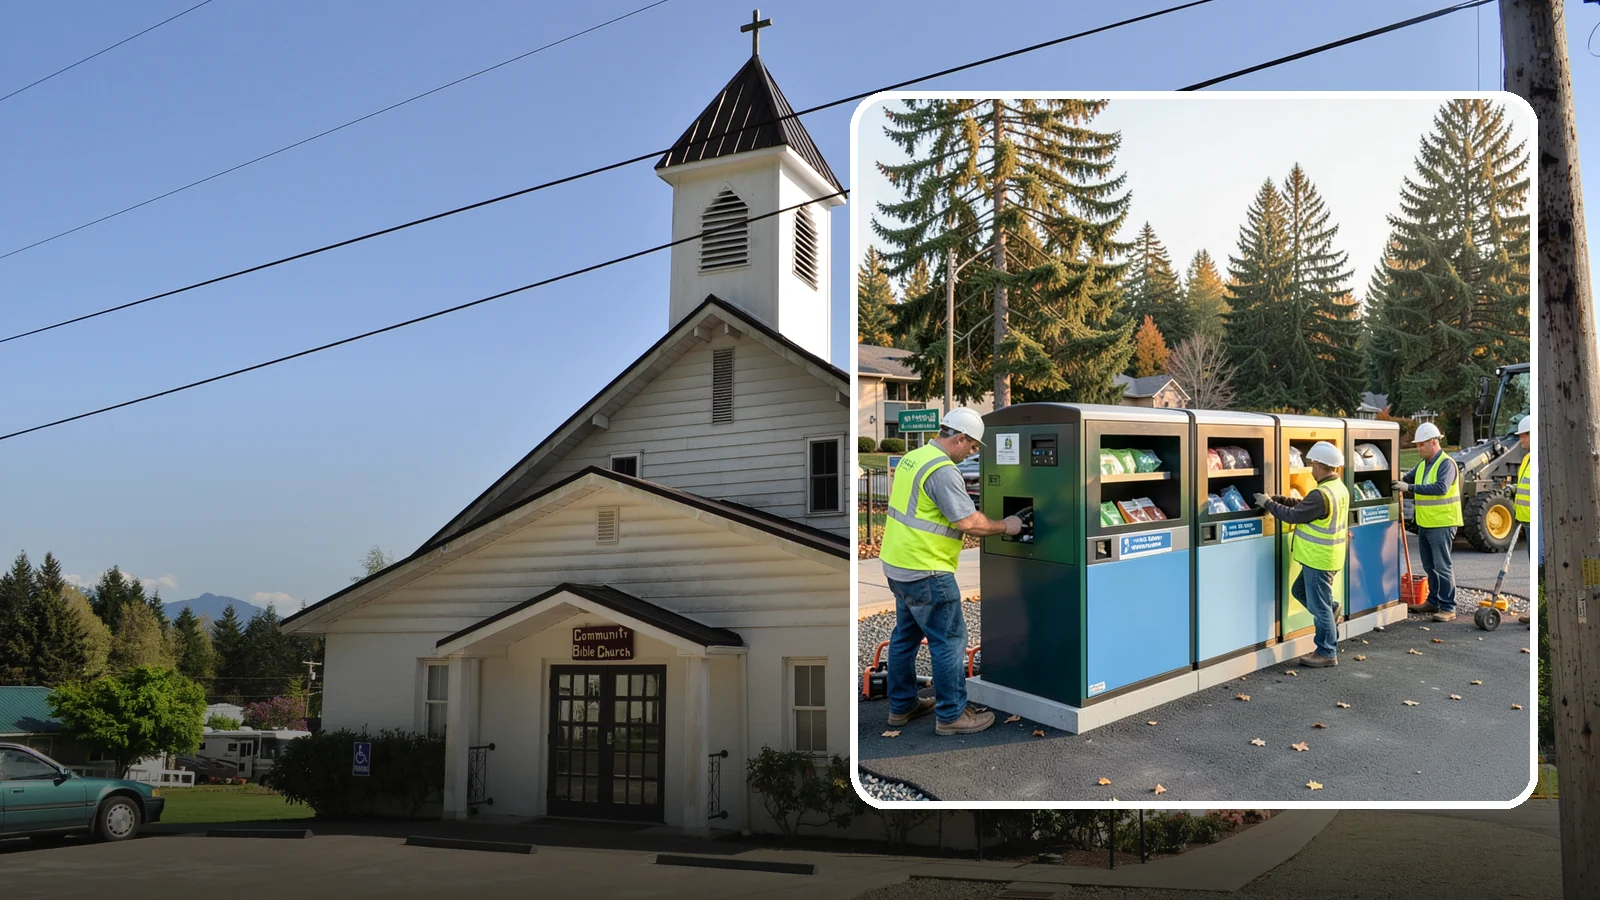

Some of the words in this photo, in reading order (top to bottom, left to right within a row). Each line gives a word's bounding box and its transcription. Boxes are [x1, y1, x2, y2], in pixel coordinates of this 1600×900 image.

[574, 627, 629, 641] Community
[572, 644, 595, 657] Bible
[597, 645, 631, 658] Church
